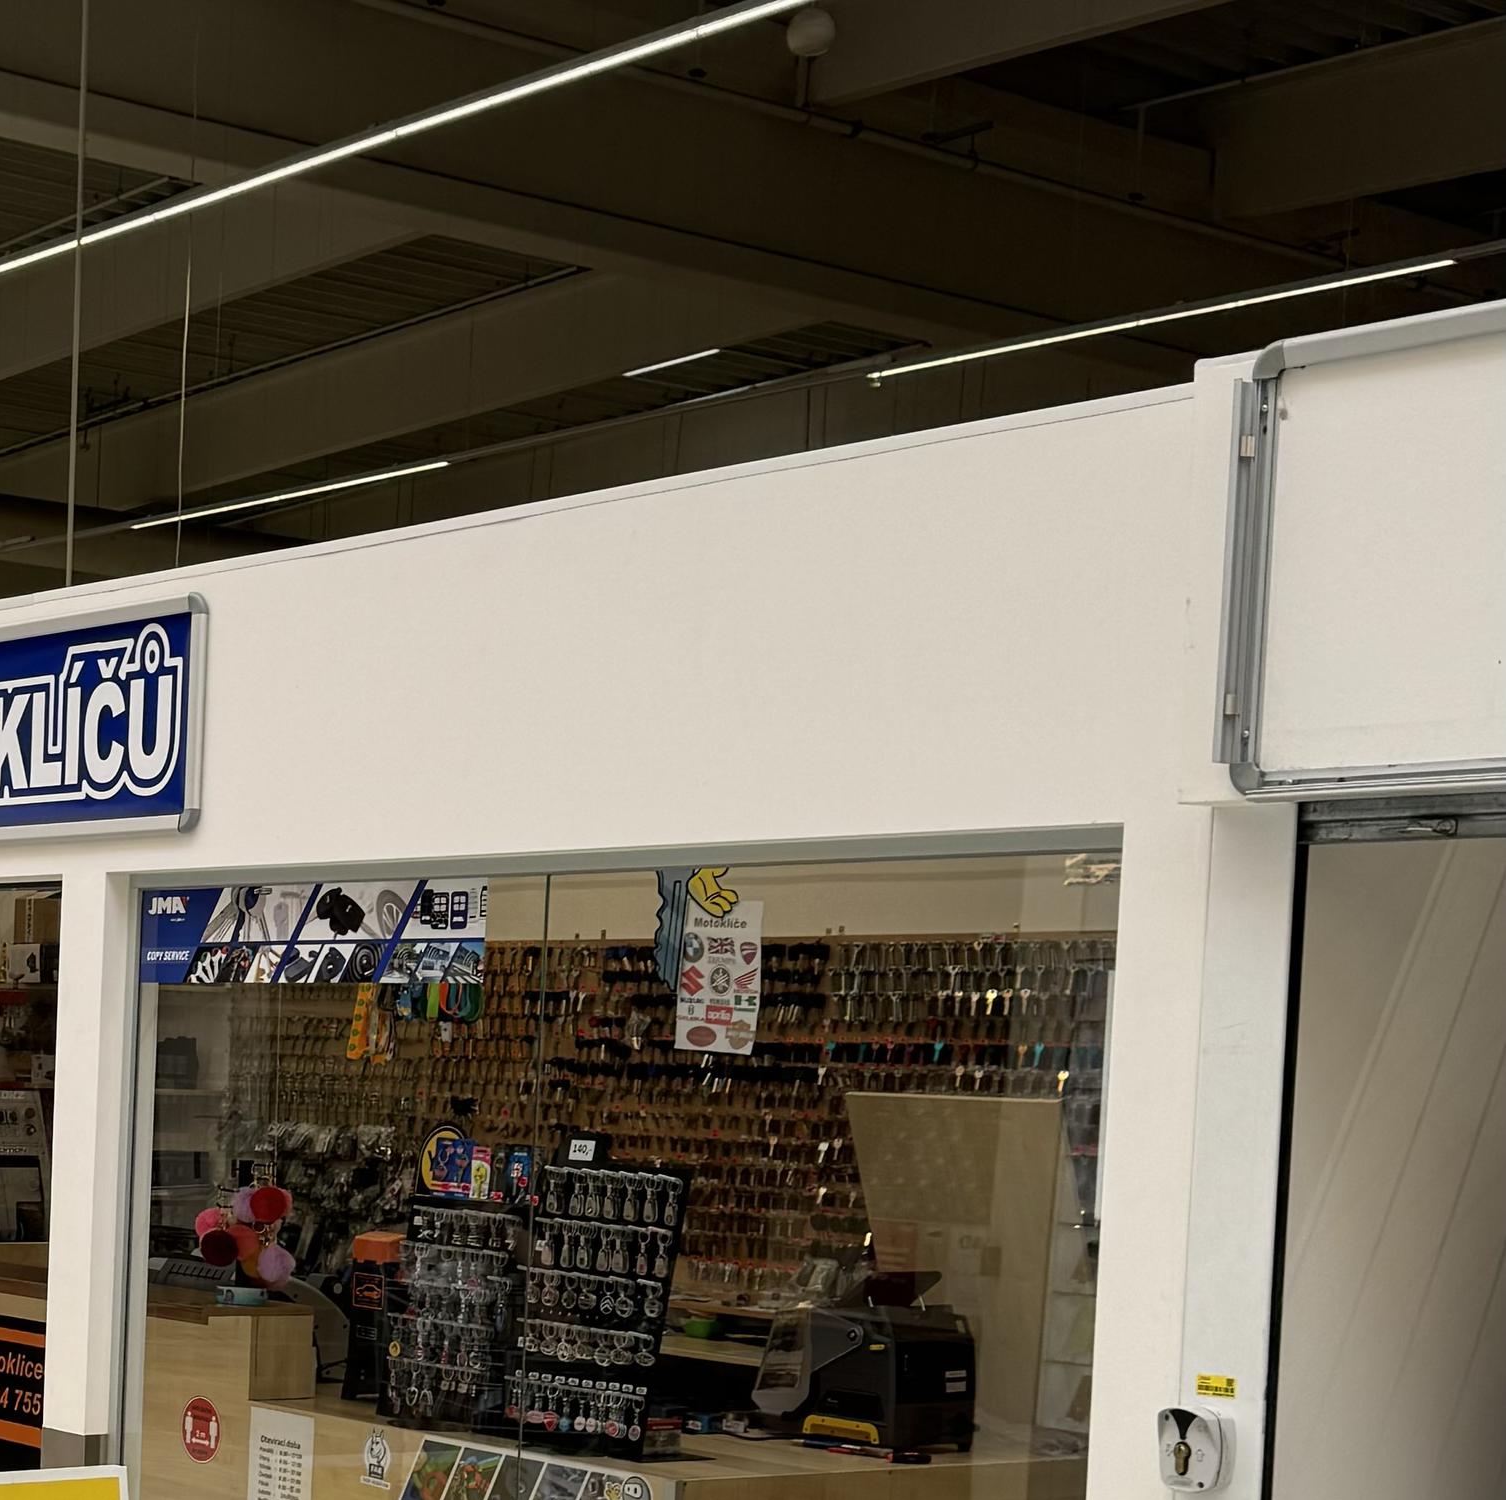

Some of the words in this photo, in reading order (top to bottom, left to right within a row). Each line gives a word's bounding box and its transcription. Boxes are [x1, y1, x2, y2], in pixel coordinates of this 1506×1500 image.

[148, 896, 187, 916] JMA
[147, 951, 164, 961] COPY
[164, 950, 190, 961] SERVICE
[14, 1389, 42, 1416] 755
